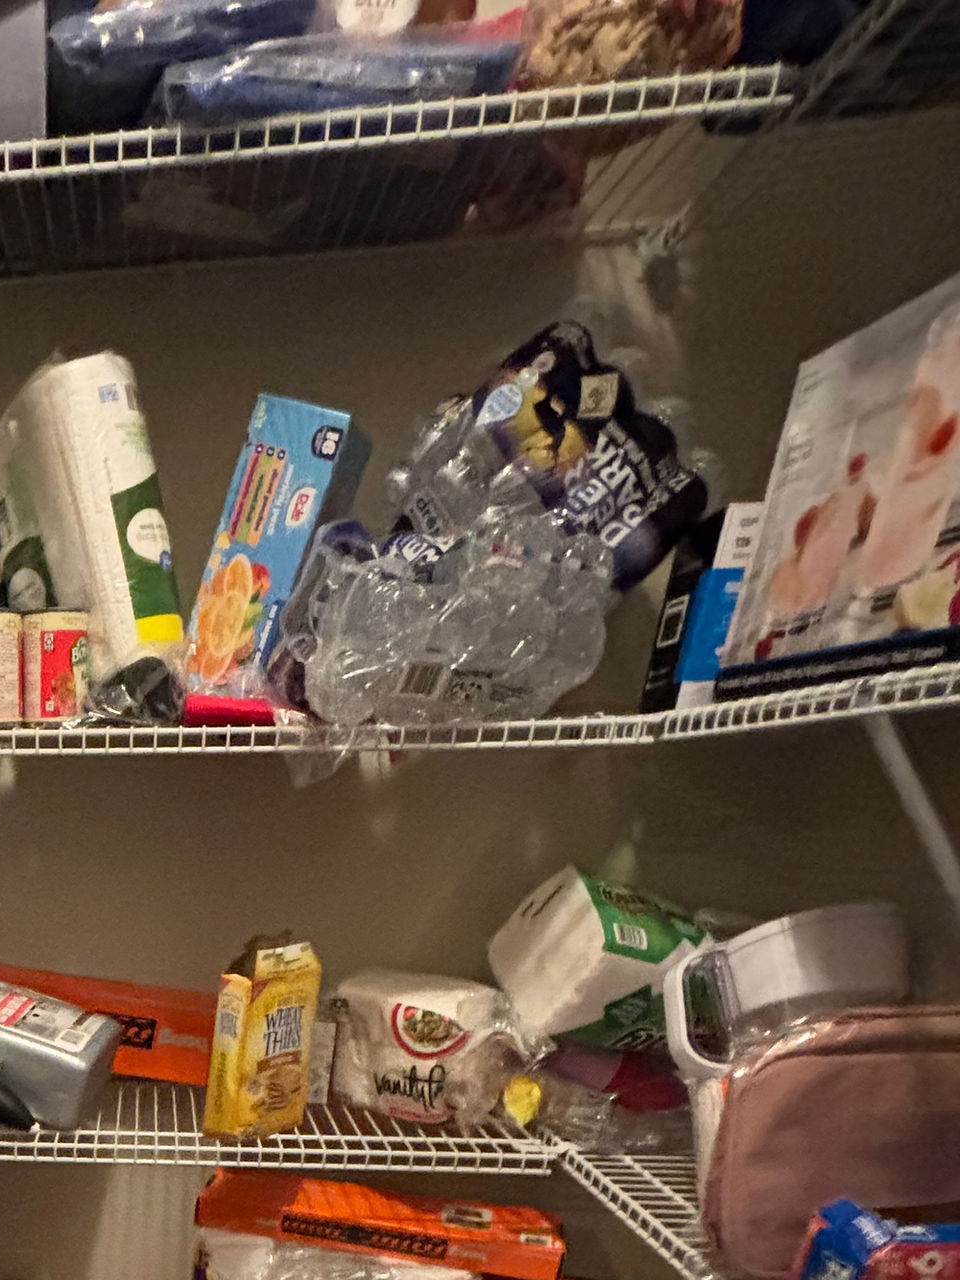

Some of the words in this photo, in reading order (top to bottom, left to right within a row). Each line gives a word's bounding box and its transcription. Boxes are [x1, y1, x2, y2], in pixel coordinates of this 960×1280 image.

[587, 431, 656, 528] PARK
[290, 492, 309, 523] Dole
[265, 1005, 304, 1031] WHEAT
[263, 1028, 302, 1056] THINS
